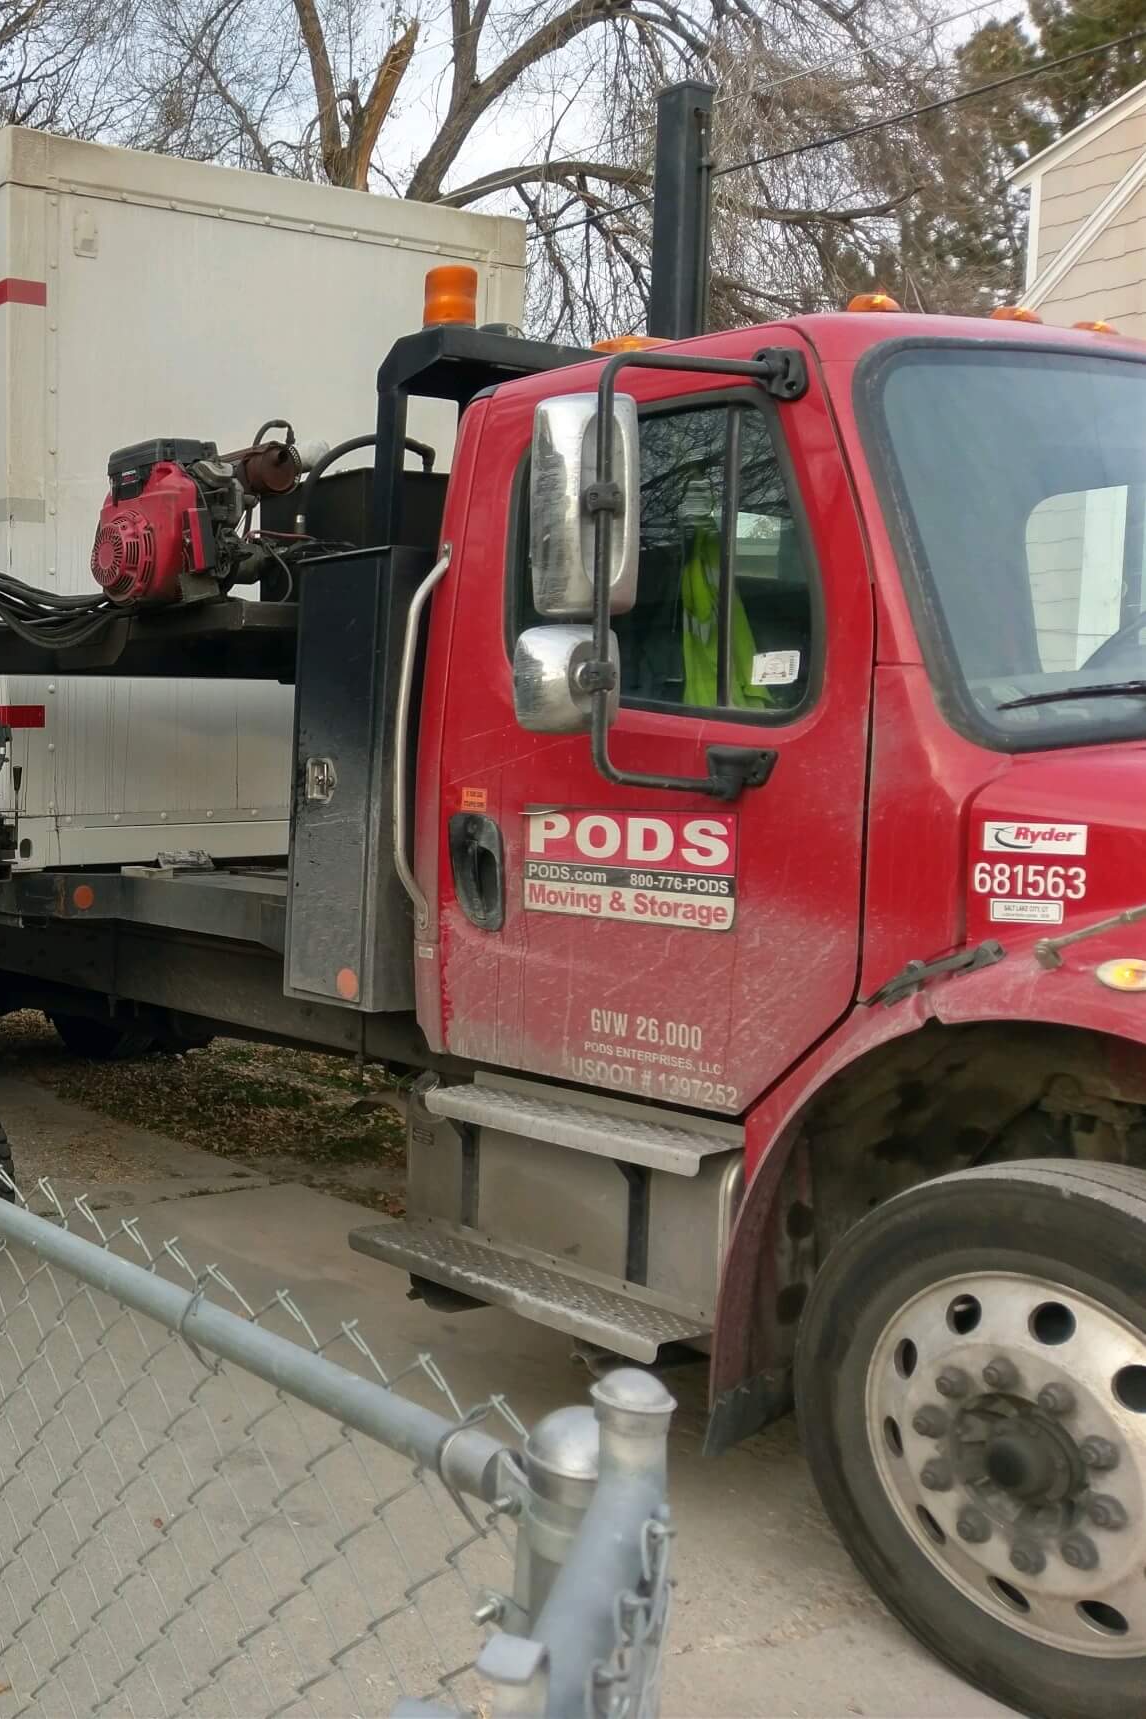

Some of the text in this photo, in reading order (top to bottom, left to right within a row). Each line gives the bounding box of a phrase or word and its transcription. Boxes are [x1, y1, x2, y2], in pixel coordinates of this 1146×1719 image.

[529, 813, 730, 867] PODS
[1014, 826, 1078, 843] Ryder
[528, 863, 729, 894] PODS.com 800-776-PODS
[974, 862, 1086, 899] 681563
[528, 883, 728, 926] Moving & Storage
[591, 1008, 702, 1051] GVW 26,000
[584, 1041, 722, 1075] PODS ENTERPRISES, LLC
[572, 1056, 738, 1109] USDOT # 1397252
